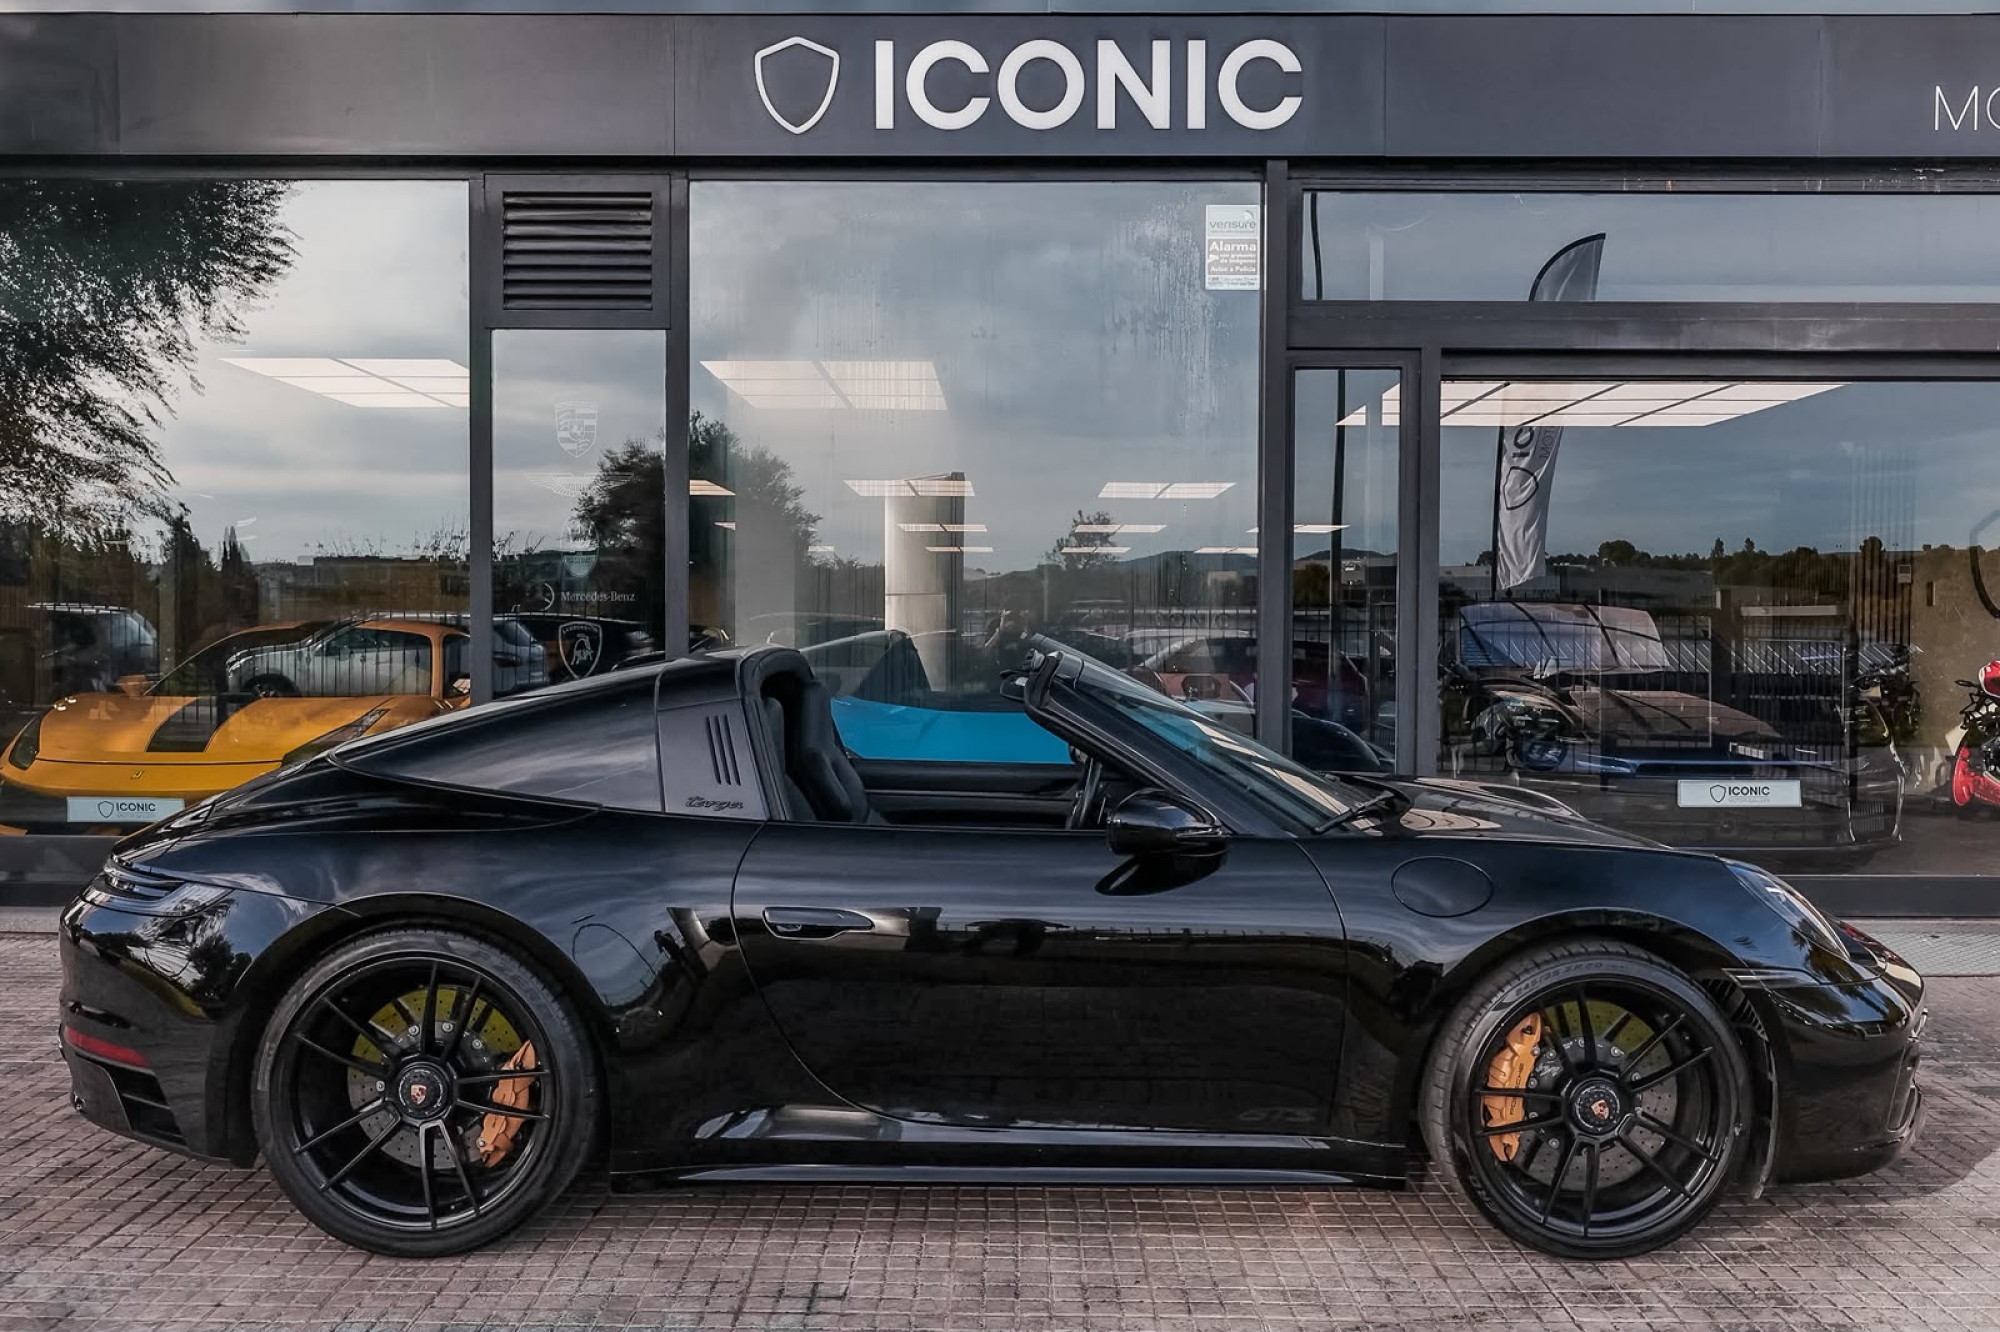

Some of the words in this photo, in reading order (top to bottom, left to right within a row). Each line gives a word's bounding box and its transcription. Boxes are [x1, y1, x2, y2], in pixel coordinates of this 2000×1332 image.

[875, 39, 1303, 131] ICONIC
[1209, 220, 1256, 229] verisure
[1209, 241, 1256, 252] Alarma
[560, 591, 636, 602] Mercedes-Benz
[1728, 786, 1770, 796] ICONIC
[116, 802, 156, 812] ICONIC
